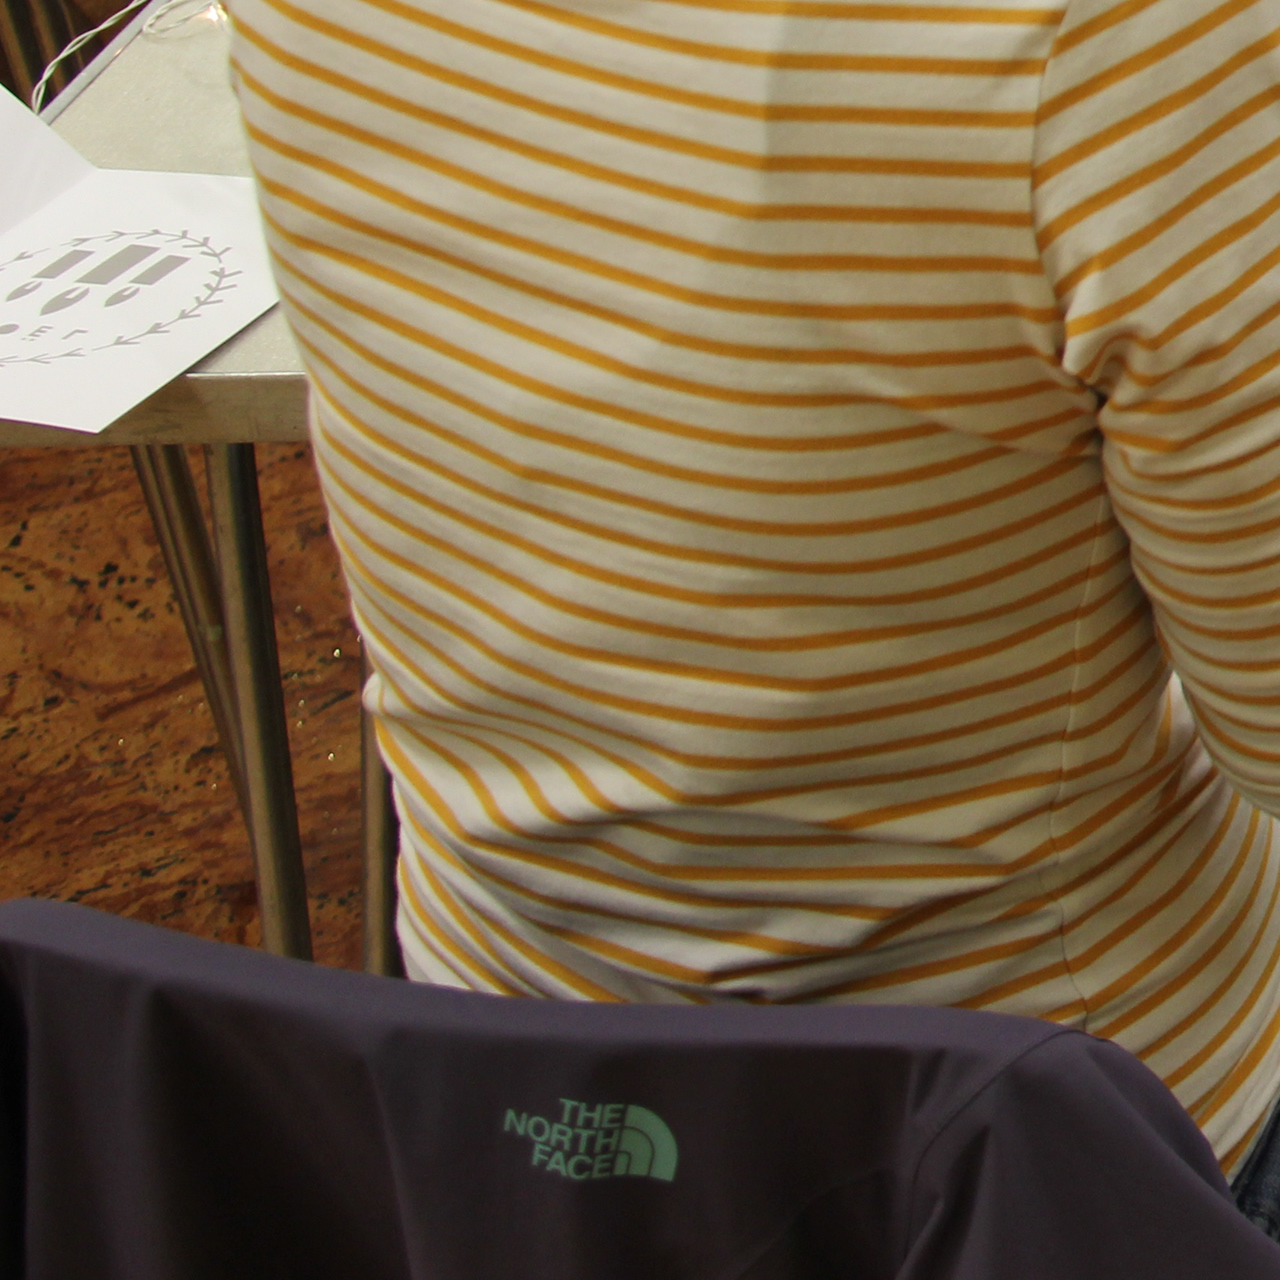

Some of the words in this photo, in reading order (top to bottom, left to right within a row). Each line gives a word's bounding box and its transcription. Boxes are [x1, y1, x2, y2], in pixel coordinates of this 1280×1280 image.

[503, 1108, 621, 1154] NORTH
[559, 1098, 624, 1128] THE
[531, 1141, 615, 1180] FACE
